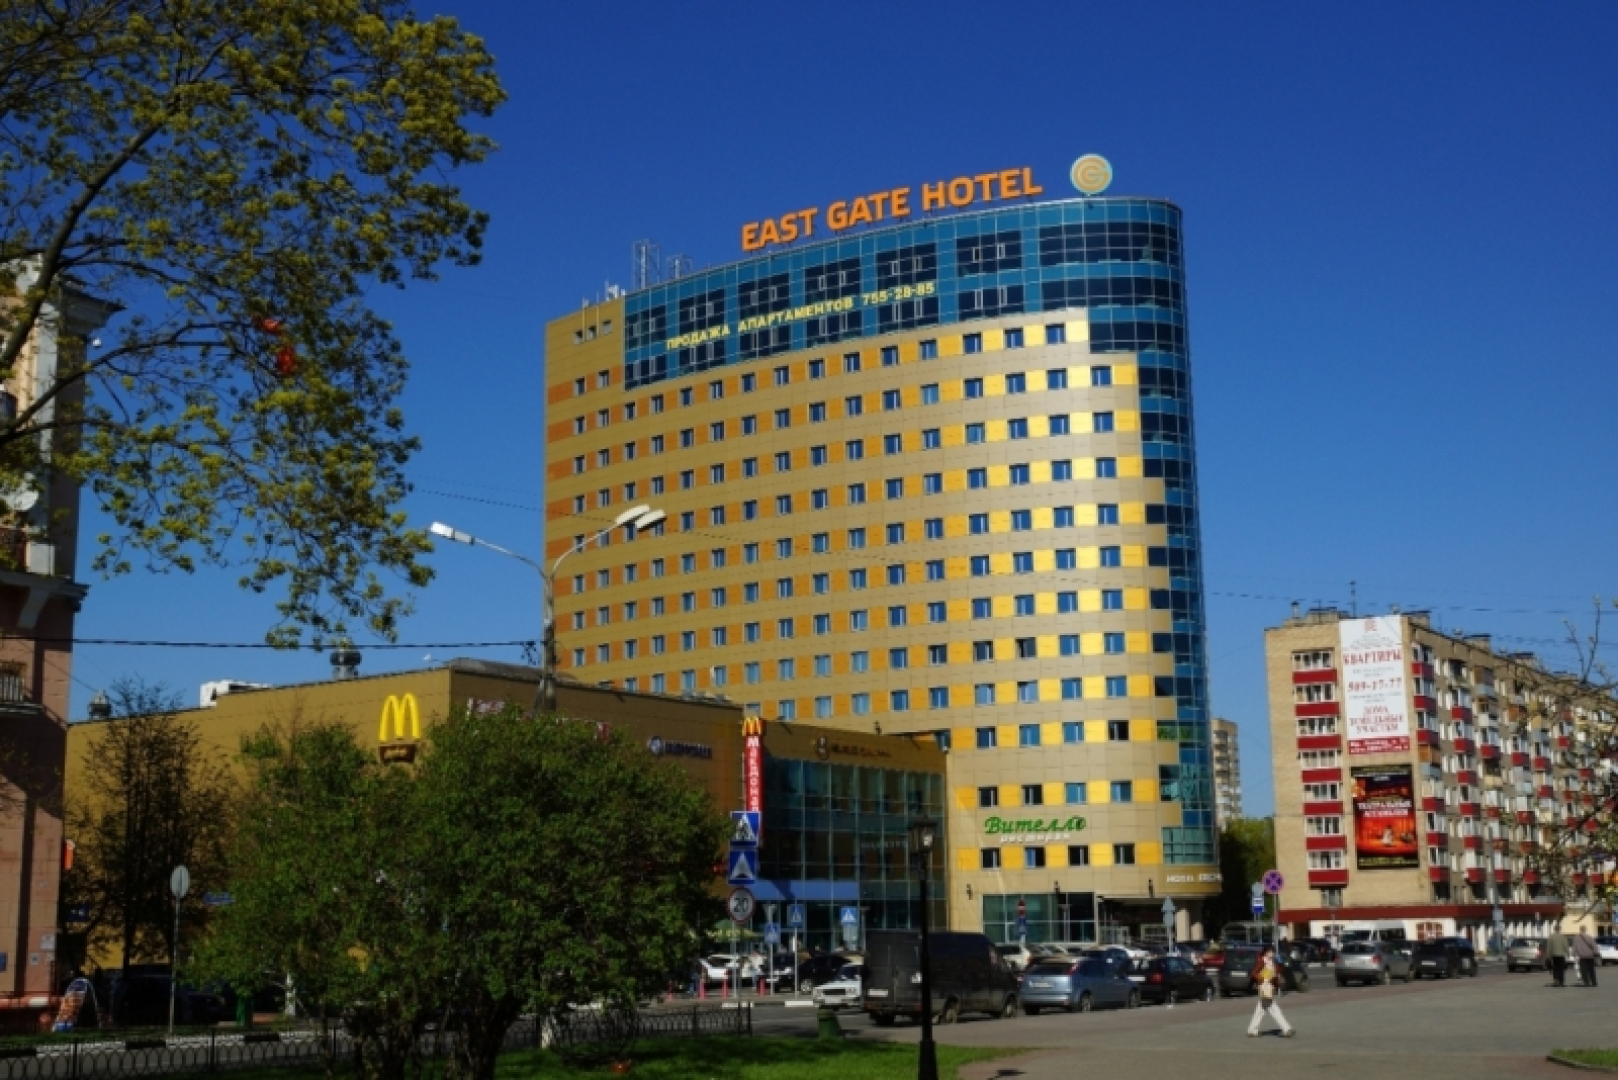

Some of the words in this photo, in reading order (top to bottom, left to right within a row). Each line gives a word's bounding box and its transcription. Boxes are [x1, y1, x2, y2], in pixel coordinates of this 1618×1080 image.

[741, 207, 818, 252] EAST
[827, 187, 911, 231] GATE
[922, 167, 1043, 211] HOTEL
[666, 323, 731, 350] ПРОДАЖА
[738, 296, 854, 333] АПАРТАМЕНТОВ
[1342, 648, 1402, 666] КВАРТИРЫ
